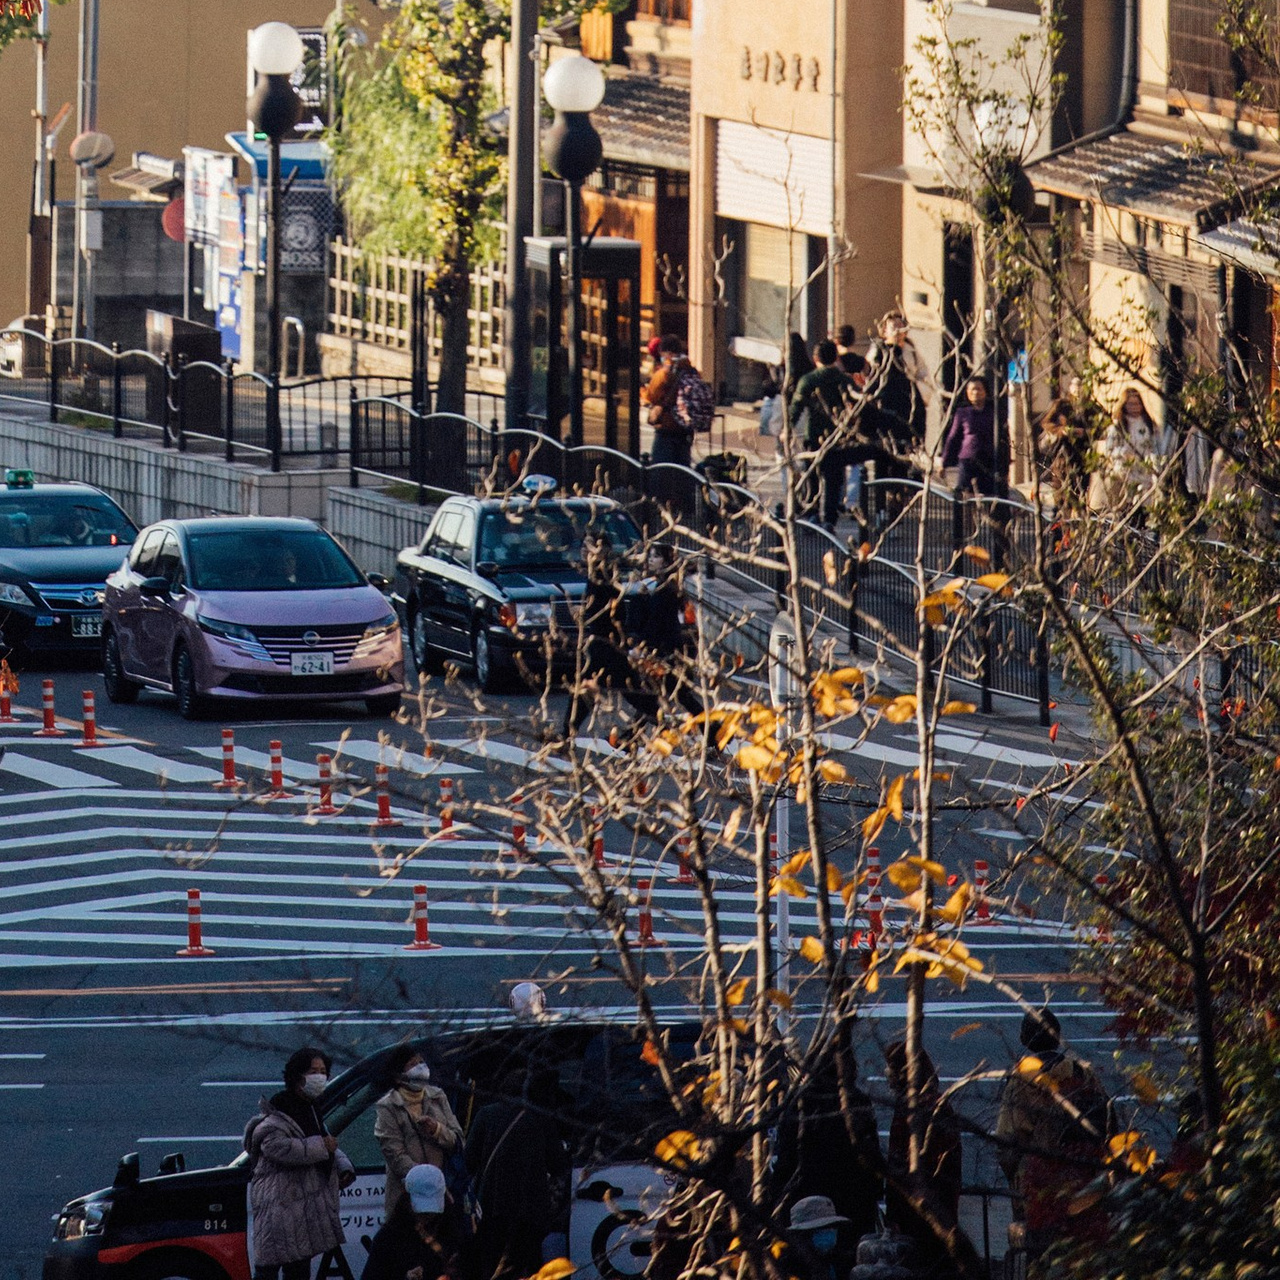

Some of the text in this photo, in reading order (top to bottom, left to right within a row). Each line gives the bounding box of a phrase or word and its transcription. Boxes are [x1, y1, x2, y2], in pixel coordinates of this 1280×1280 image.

[301, 661, 331, 673] 62-41
[340, 1187, 386, 1198] AKO TAX
[204, 1219, 227, 1230] 814
